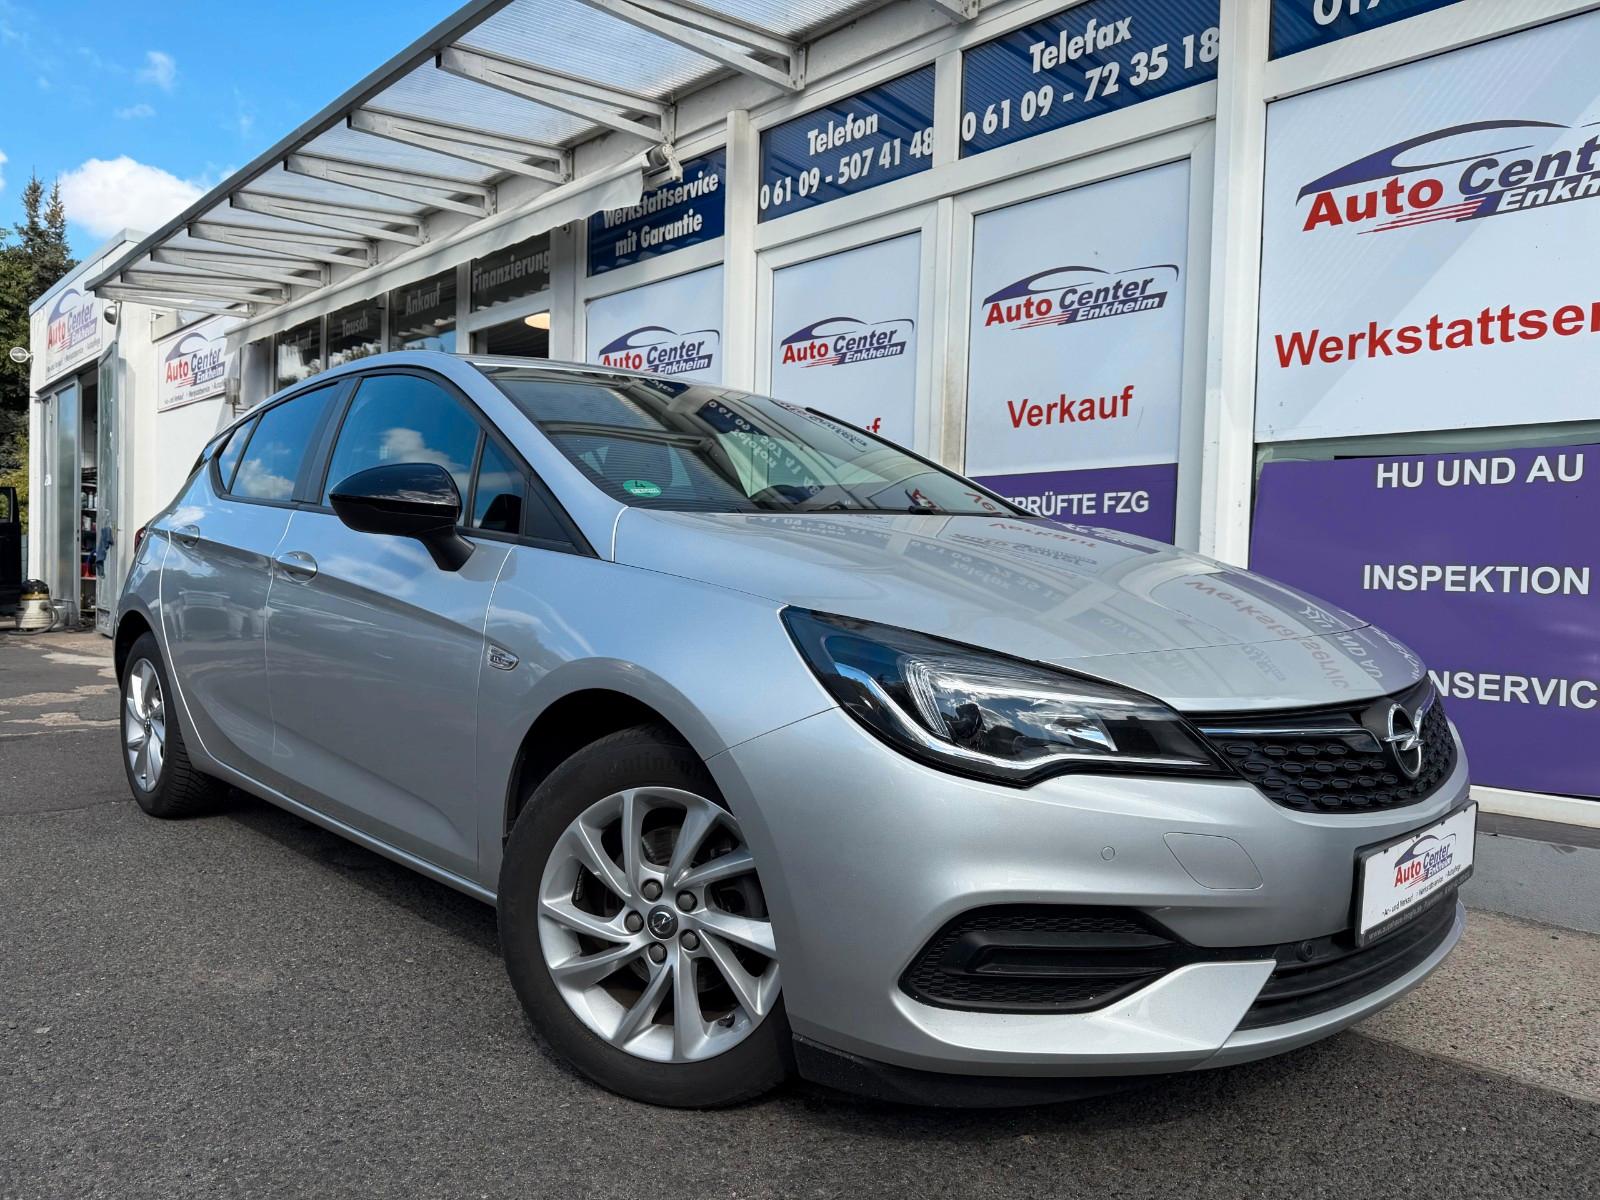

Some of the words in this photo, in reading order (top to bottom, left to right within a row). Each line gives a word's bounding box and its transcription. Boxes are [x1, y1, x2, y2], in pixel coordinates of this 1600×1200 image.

[1030, 16, 1132, 74] Telefax
[962, 111, 977, 141] 0
[982, 99, 1010, 134] 61
[1020, 85, 1054, 121] 09
[1083, 61, 1120, 103] 72
[1130, 44, 1168, 86] 35
[1182, 27, 1219, 69] 18
[808, 113, 878, 156] Telefon
[760, 185, 770, 210] 0
[773, 176, 792, 206] 61
[799, 167, 820, 197] 09
[838, 147, 874, 185] 507
[879, 138, 901, 169] 41
[910, 127, 934, 158] 48
[1302, 176, 1443, 232] Auto
[1458, 135, 1600, 196] Cent
[603, 170, 718, 229] Werkstattservice
[1497, 174, 1600, 212] Enkh
[615, 229, 637, 256] mit
[641, 208, 702, 248] Garantie
[472, 250, 551, 292] Finanzierung
[406, 282, 441, 316] Ankauf
[984, 296, 1053, 327] Auto
[1059, 278, 1155, 310] Center
[1075, 297, 1161, 321] Enkheim
[48, 320, 66, 350] Auto
[67, 303, 94, 333] Center
[342, 311, 368, 337] Tausch
[166, 360, 189, 384] Auto
[191, 348, 222, 372] Center
[647, 341, 704, 365] Center
[658, 357, 709, 374] Enkheim
[782, 340, 829, 364] Auto
[833, 329, 898, 353] Center
[844, 345, 901, 362] Enkheim
[1007, 385, 1134, 429] Verkauf
[1376, 461, 1424, 489] HU
[1437, 458, 1516, 487] UND
[1525, 454, 1584, 484] AU
[1103, 491, 1150, 514] FZG
[1363, 564, 1590, 595] INSPEKTION
[1394, 861, 1421, 888] Auto
[1423, 843, 1450, 869] Center
